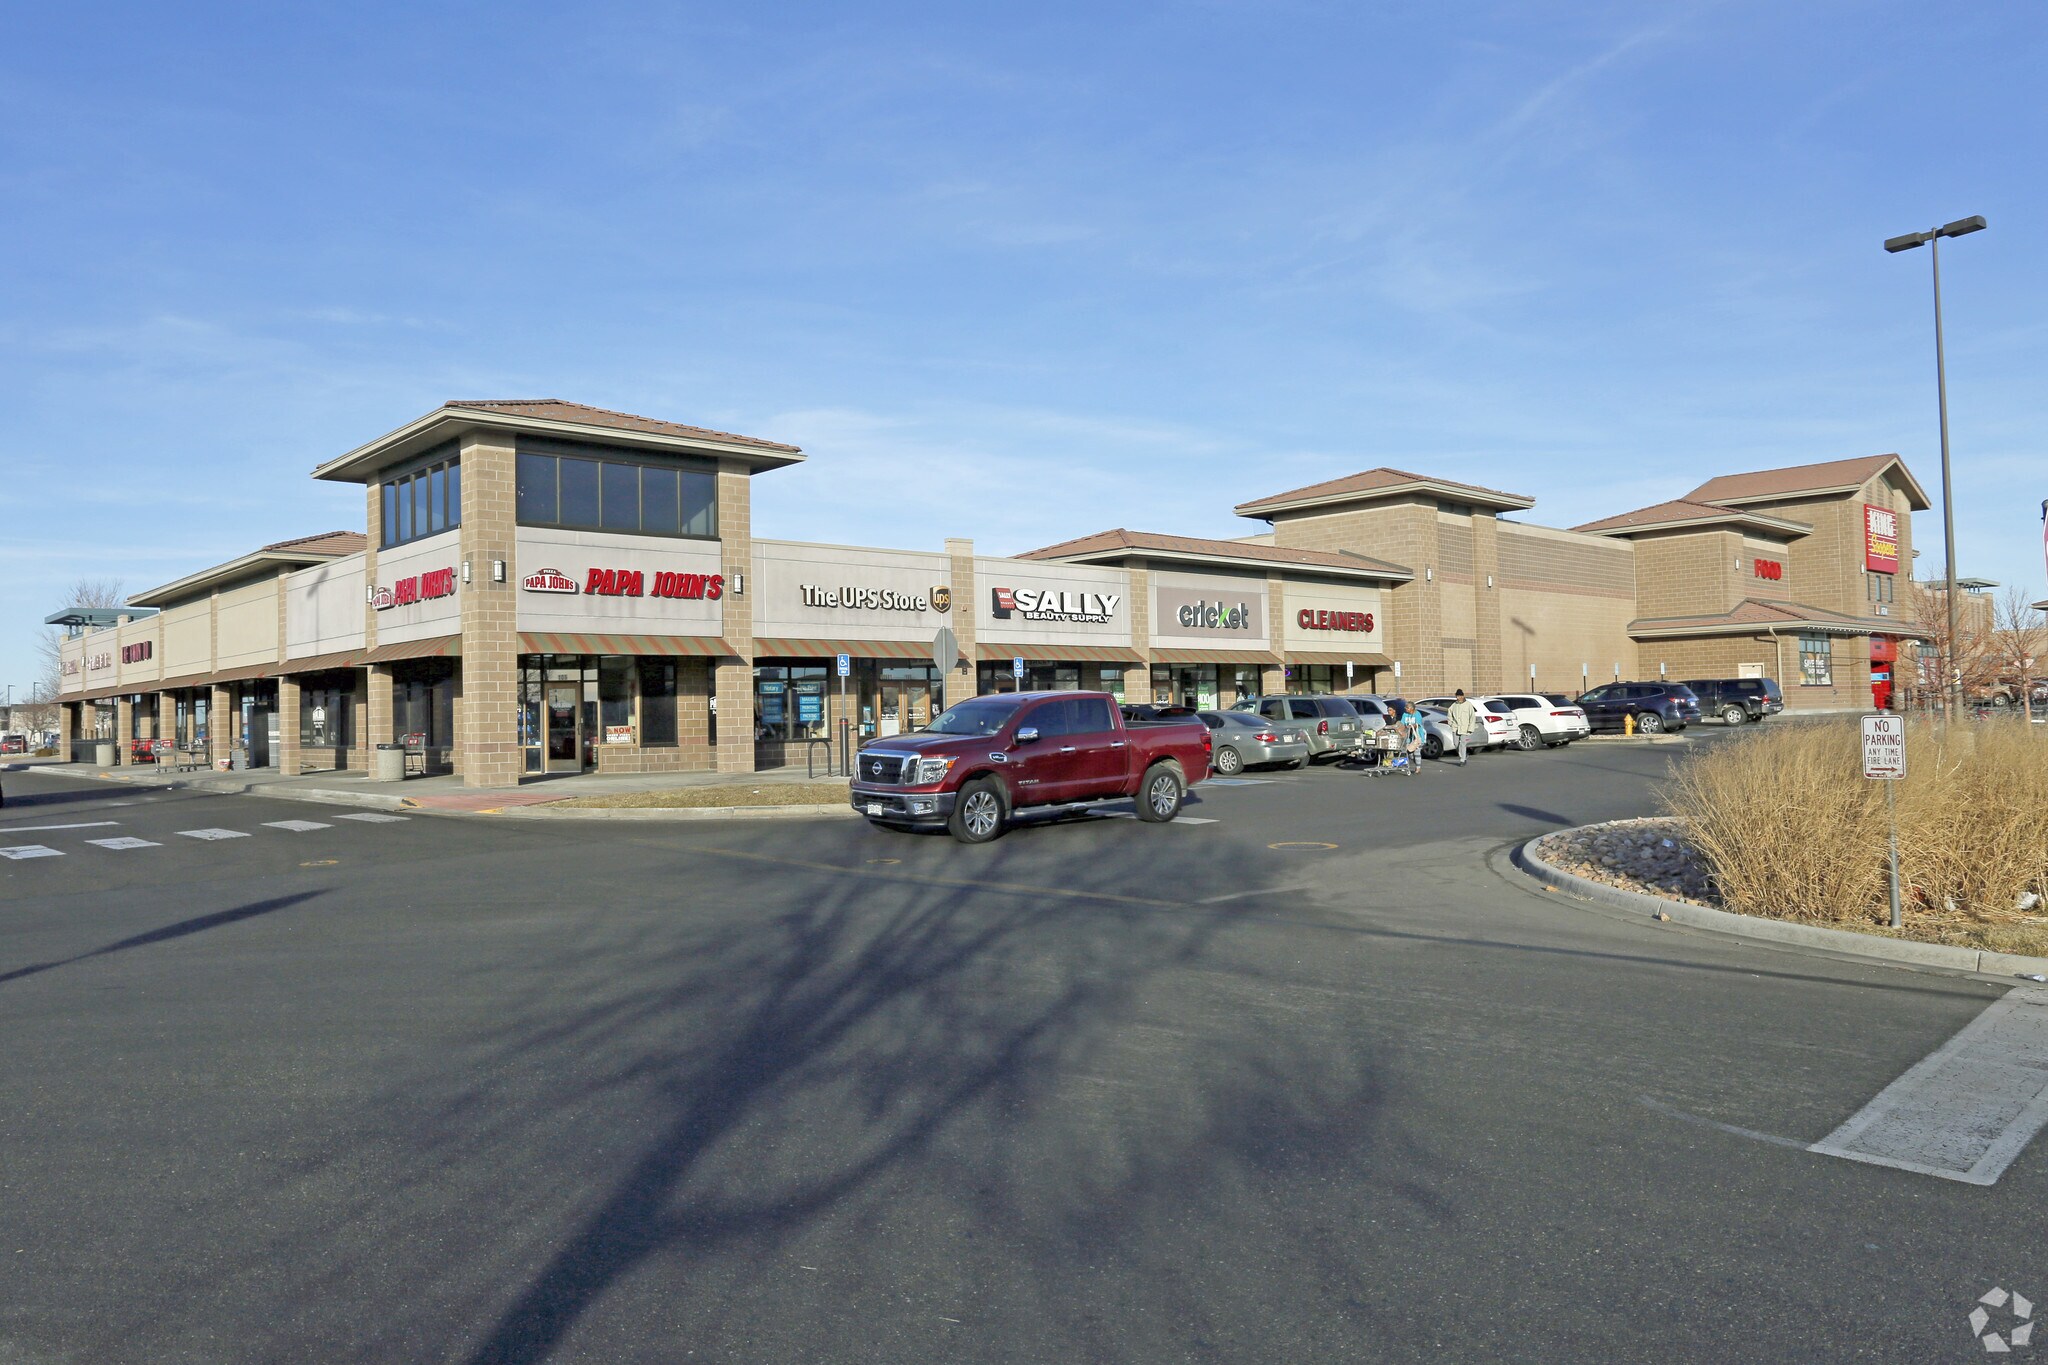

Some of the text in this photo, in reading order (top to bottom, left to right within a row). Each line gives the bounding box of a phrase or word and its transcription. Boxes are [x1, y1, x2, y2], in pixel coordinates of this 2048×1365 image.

[1868, 510, 1894, 537] KING
[1754, 558, 1782, 580] FOOD
[394, 567, 454, 605] PAPA JOHN'S
[525, 575, 546, 588] PAPA
[584, 568, 723, 600] PAPA JOHN'S
[802, 584, 926, 611] The UPS Store
[934, 592, 949, 608] ups
[1015, 588, 1120, 615] SALLY
[1026, 611, 1110, 623] BEAUTY SUPPLY
[1179, 601, 1248, 629] cricket
[1299, 609, 1374, 632] CLEANERS
[1874, 720, 1890, 733] NO
[1865, 734, 1901, 746] PARKING
[1867, 756, 1900, 766] FIRE LANE
[1868, 748, 1899, 757] ANY TIME
